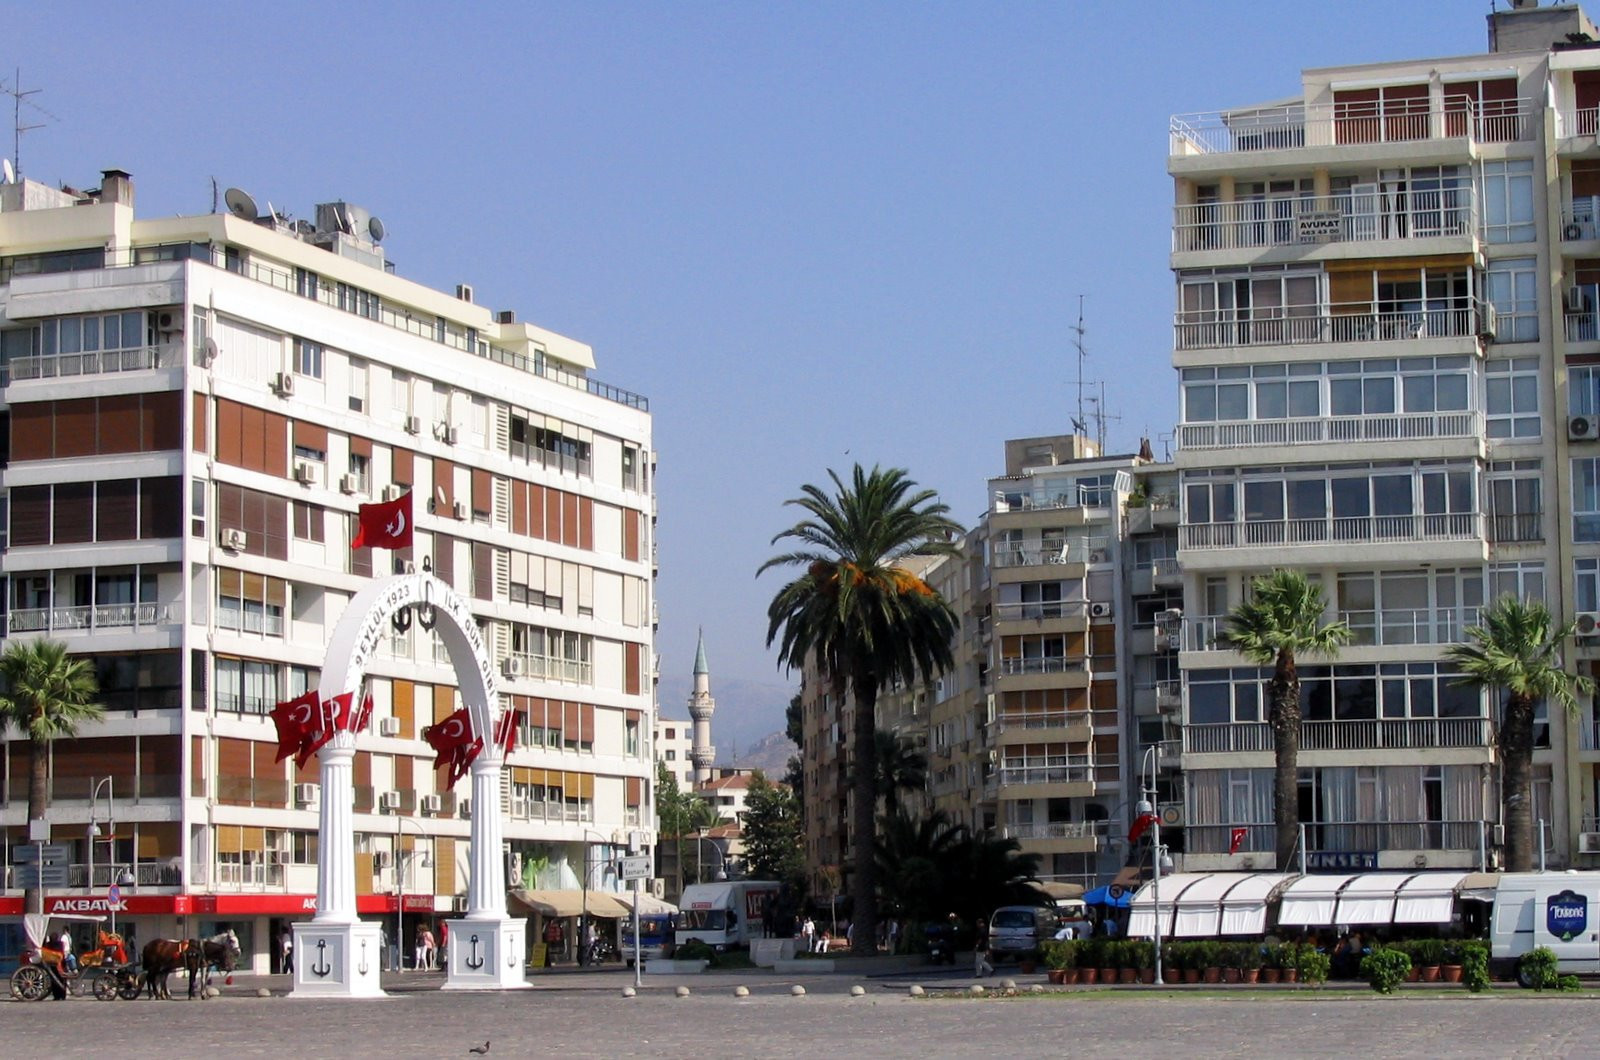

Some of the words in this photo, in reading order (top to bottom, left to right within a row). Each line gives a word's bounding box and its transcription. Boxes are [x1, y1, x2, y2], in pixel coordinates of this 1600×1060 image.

[1300, 220, 1340, 229] AVUKAT
[355, 655, 363, 667] 9
[387, 585, 410, 608] 1923
[52, 899, 128, 911] AKBANK
